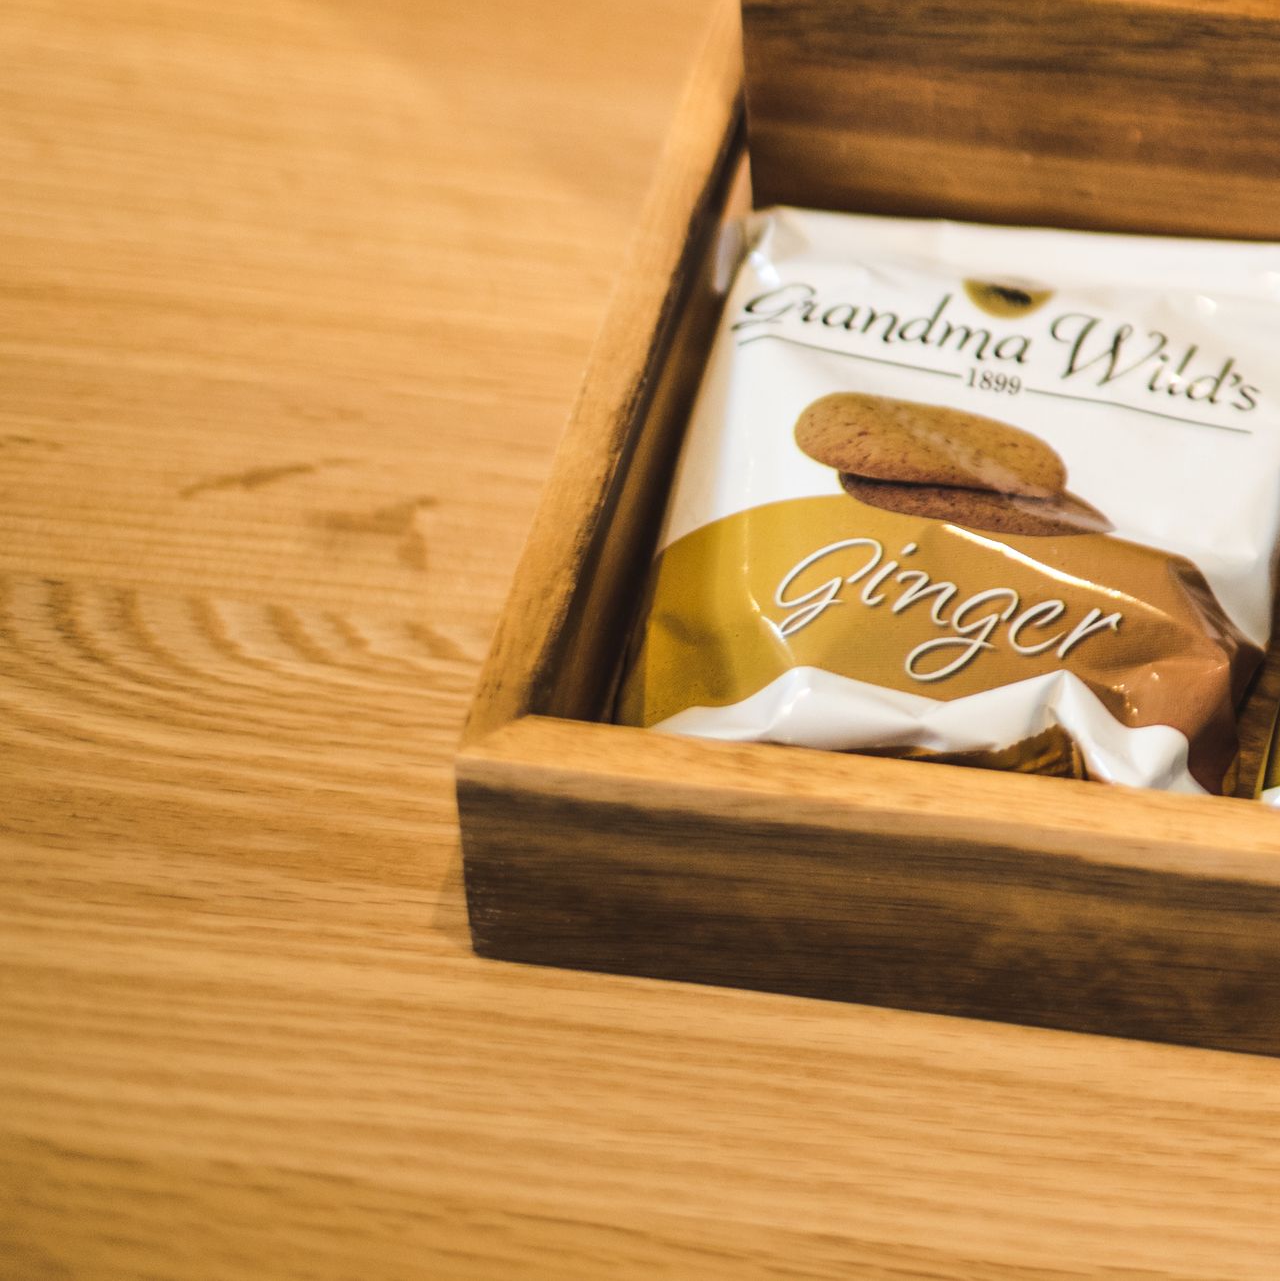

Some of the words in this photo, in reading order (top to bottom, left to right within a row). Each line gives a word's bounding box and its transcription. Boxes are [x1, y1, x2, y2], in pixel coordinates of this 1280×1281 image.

[731, 282, 1034, 366] Grandma
[1049, 311, 1263, 413] Wild's
[964, 366, 1023, 397] 1899
[773, 536, 1123, 683] Ginger
